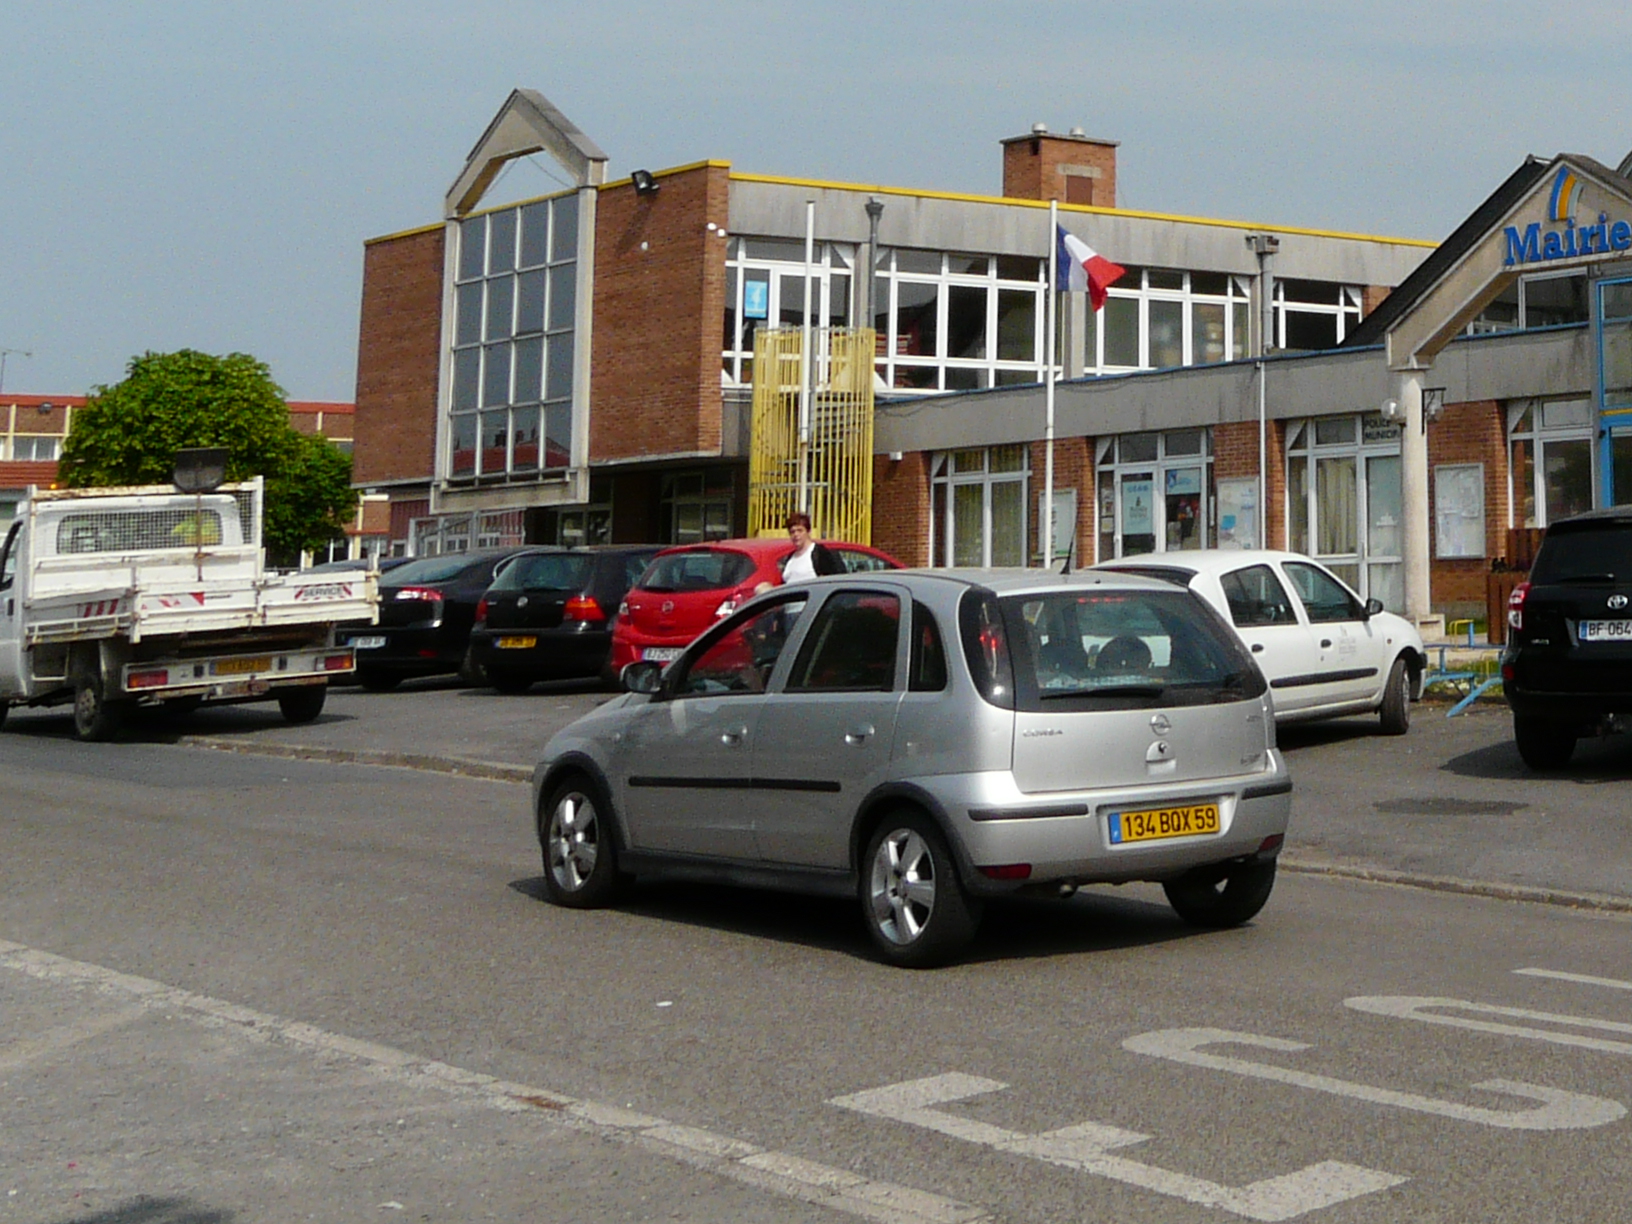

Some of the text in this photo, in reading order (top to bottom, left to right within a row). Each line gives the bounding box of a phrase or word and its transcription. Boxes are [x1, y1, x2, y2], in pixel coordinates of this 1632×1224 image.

[1504, 212, 1632, 266] Mairie
[304, 586, 342, 597] SERVICE
[1124, 813, 1156, 838] 134
[1194, 807, 1217, 830] 59
